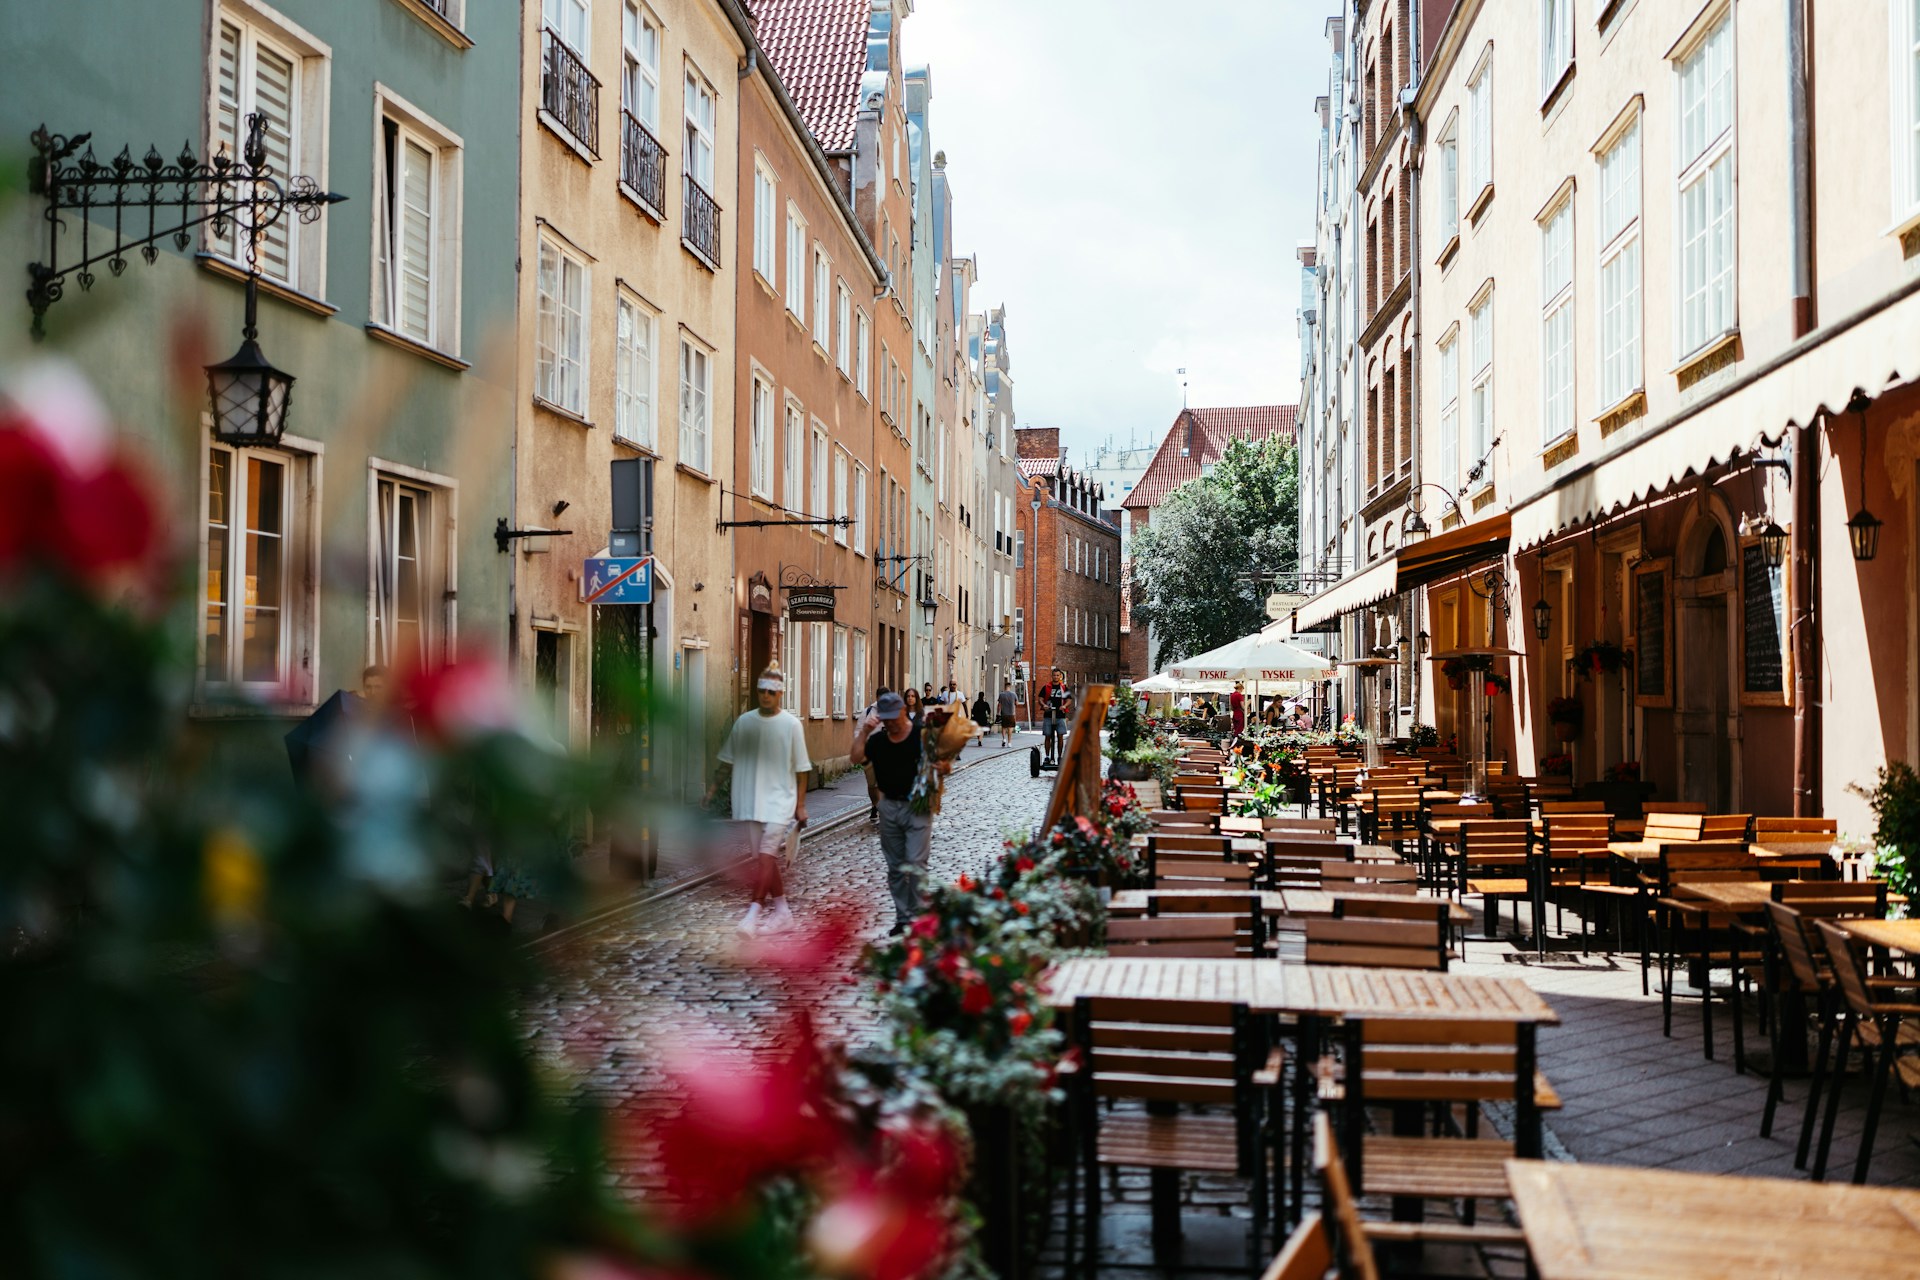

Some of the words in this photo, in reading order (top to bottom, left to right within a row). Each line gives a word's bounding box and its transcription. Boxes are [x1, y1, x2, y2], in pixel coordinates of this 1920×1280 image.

[790, 596, 808, 605] SZAFA
[796, 608, 828, 616] Souvenir
[1300, 636, 1320, 645] FAMILIA
[1199, 670, 1228, 679] TYSKIE
[1260, 670, 1295, 679] TYSKIE
